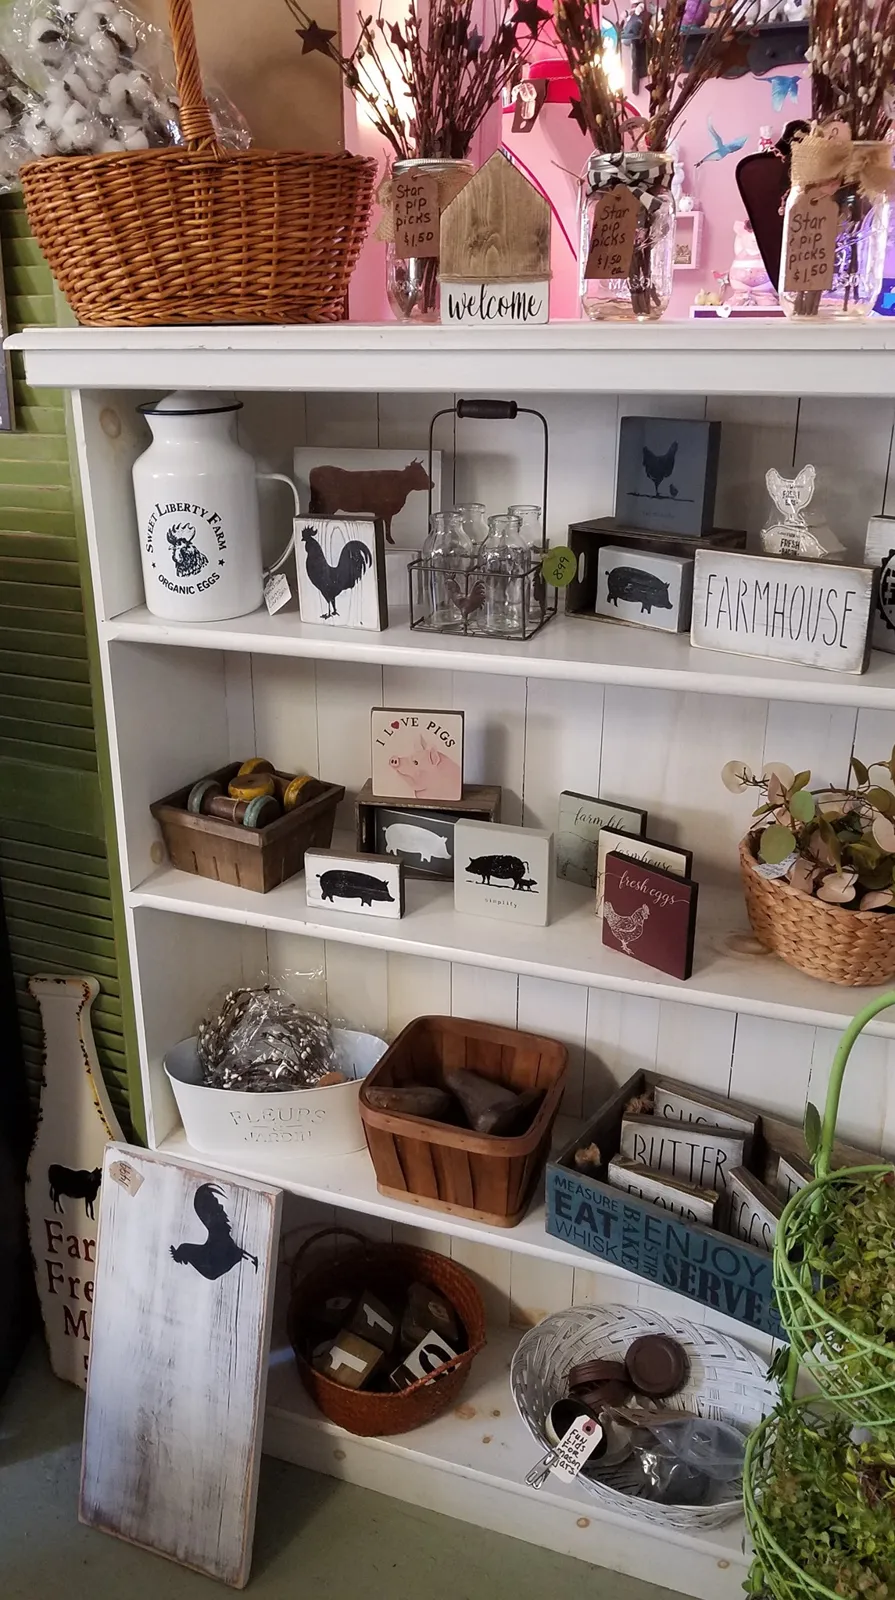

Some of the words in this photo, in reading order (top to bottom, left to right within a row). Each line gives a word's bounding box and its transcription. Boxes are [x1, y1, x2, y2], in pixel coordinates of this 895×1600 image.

[396, 184, 424, 199] Star
[406, 198, 427, 214] pip
[600, 206, 630, 220] Star
[395, 212, 432, 232] picks
[601, 222, 620, 237] pip
[790, 212, 827, 233] Star
[404, 231, 434, 247] $1.50
[591, 233, 626, 253] picks
[801, 233, 823, 248] pip
[789, 248, 826, 270] picks
[448, 283, 543, 321] welcome
[158, 574, 196, 595] ORGANIC
[196, 572, 221, 592] EGGS
[705, 574, 856, 649] FARMHOUSE
[376, 738, 386, 747] I
[426, 721, 456, 748] PIGS
[574, 807, 603, 826] farm
[616, 870, 649, 893] fresh
[649, 888, 679, 907] eggs
[485, 898, 518, 908] simplify
[633, 1133, 728, 1190] BUTTER
[554, 1175, 618, 1212] MEASURE
[554, 1190, 619, 1240] EAT
[44, 1218, 96, 1262] Far
[555, 1218, 619, 1260] WHISK
[621, 1205, 641, 1270] BAKE
[643, 1241, 659, 1278] STIR
[644, 1215, 767, 1287] ENJOY
[44, 1259, 94, 1303] Fre
[662, 1252, 763, 1326] SERVE
[562, 1441, 579, 1458] FOR
